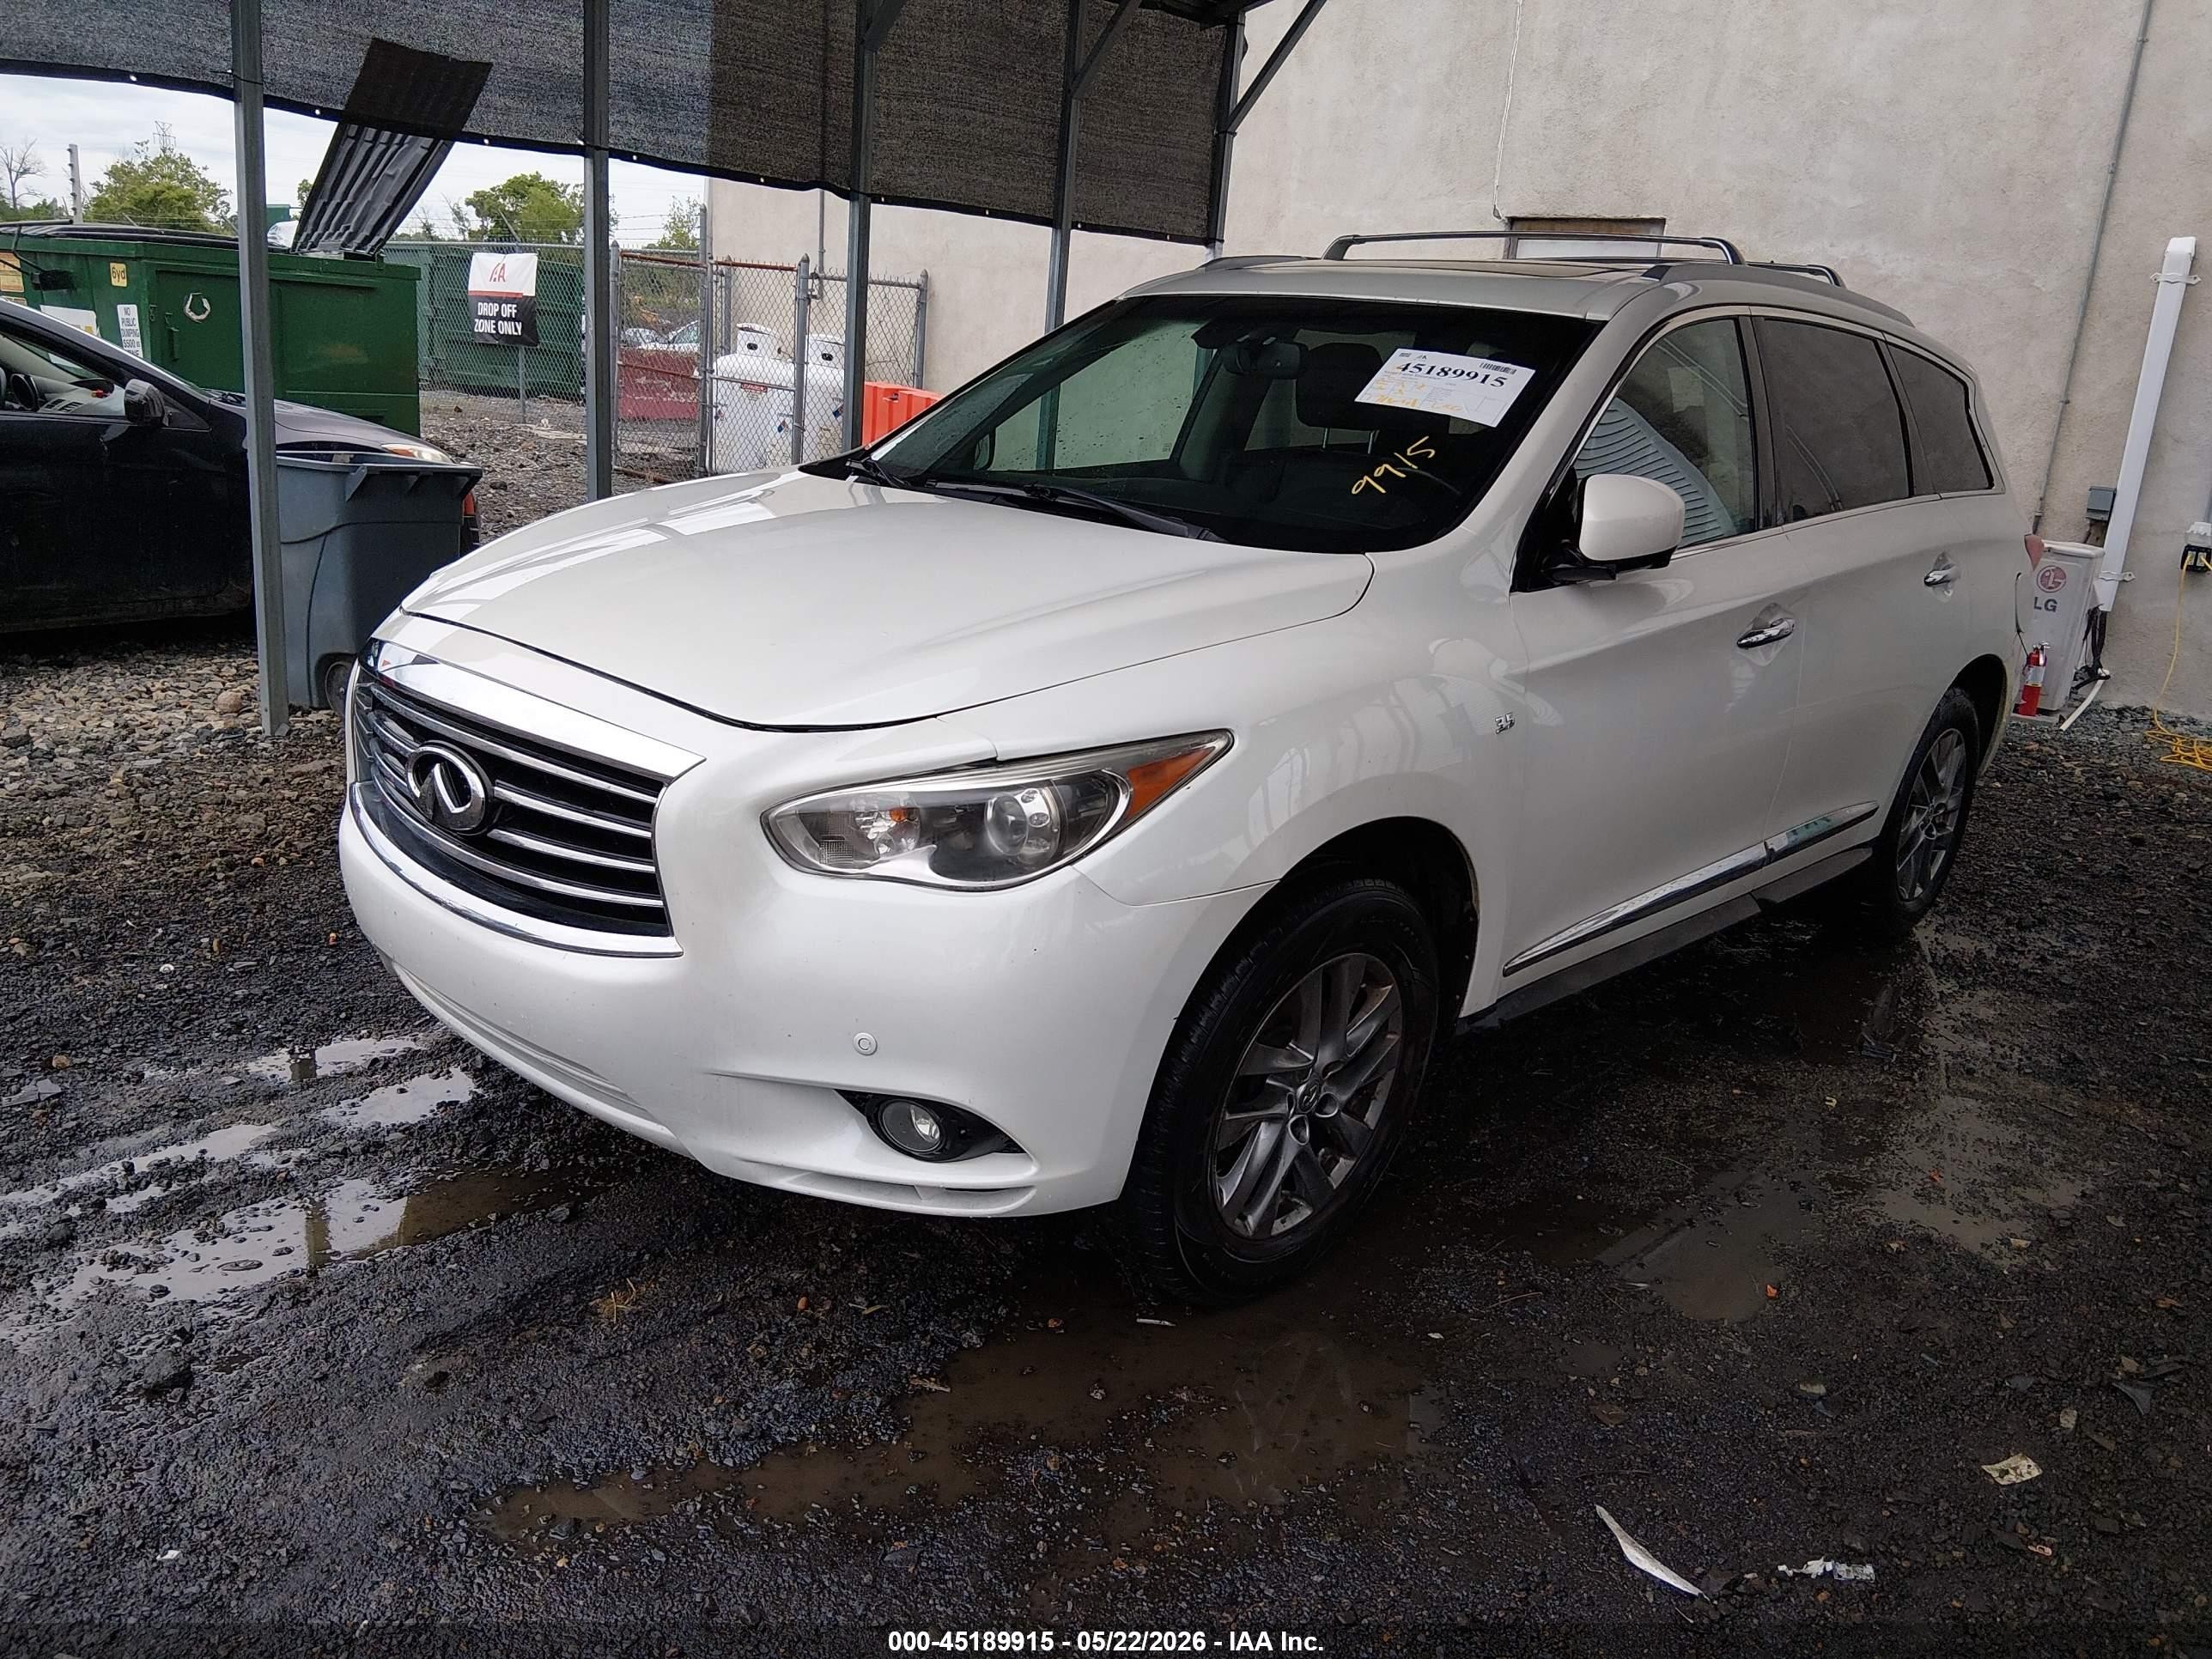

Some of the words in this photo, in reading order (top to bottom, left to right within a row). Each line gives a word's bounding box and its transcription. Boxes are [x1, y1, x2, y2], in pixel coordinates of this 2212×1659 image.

[112, 267, 125, 282] 6yd
[124, 307, 131, 316] NO
[477, 302, 499, 317] DROP
[501, 304, 517, 318] OFF
[121, 318, 137, 327] PUBLIC
[474, 319, 496, 333] ZONE
[498, 320, 522, 336] ONLY
[121, 329, 139, 337] DUMPING
[1396, 362, 1508, 387] 45189915
[1352, 435, 1436, 495] 9915
[2033, 596, 2058, 612] LG
